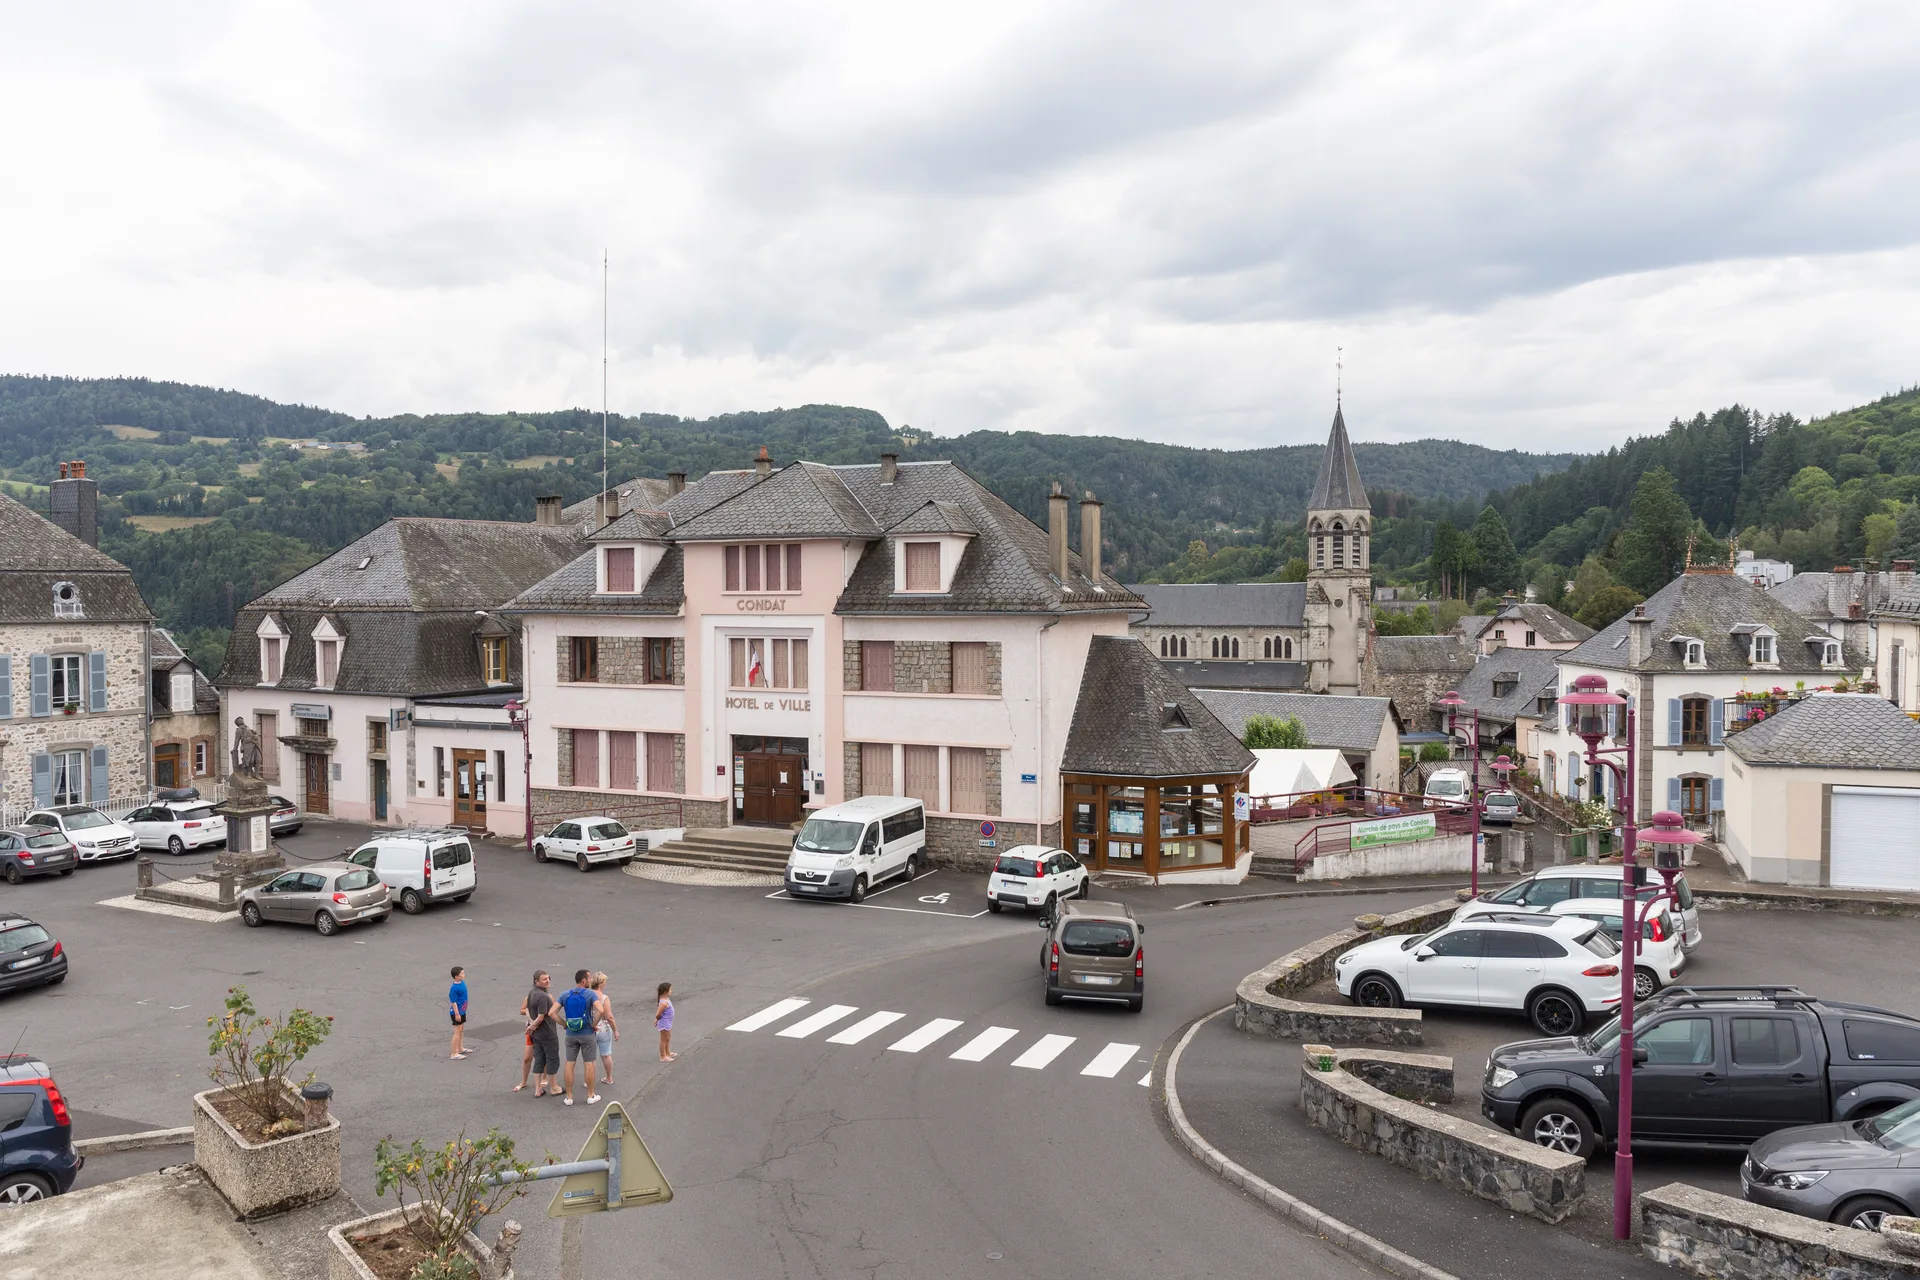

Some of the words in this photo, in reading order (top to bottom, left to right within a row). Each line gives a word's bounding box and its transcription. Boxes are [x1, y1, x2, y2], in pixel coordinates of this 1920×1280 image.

[737, 599, 786, 611] CONDAT
[725, 697, 759, 710] HOTEL
[764, 701, 774, 710] DE
[779, 699, 811, 711] VILLE
[1357, 824, 1378, 834] Marché
[1388, 822, 1400, 830] pays
[1401, 820, 1409, 828] de
[1410, 818, 1430, 827] Condat
